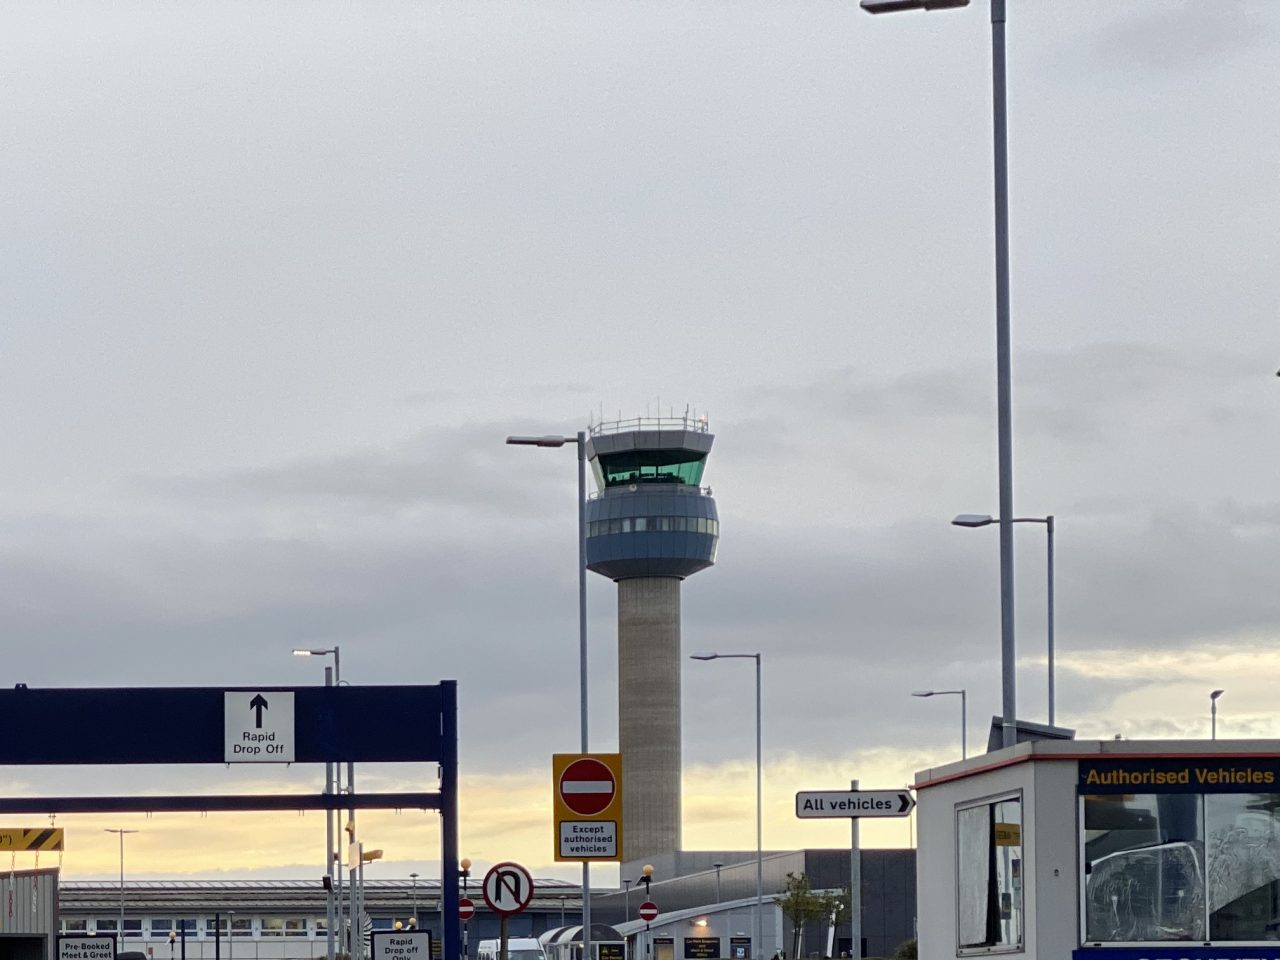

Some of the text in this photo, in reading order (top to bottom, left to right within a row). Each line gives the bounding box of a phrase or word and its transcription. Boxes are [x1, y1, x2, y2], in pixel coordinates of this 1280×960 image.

[242, 731, 276, 743] Rapid
[233, 744, 284, 755] Drop Off
[1086, 768, 1275, 785] Authorised Vehicles
[803, 798, 892, 811] All vehicles
[572, 825, 604, 834] Except
[564, 834, 613, 843] authorised
[570, 844, 607, 853] vehicles
[389, 938, 413, 946] Rapid
[62, 951, 112, 959] Meet & Greet
[385, 946, 418, 955] Drop off
